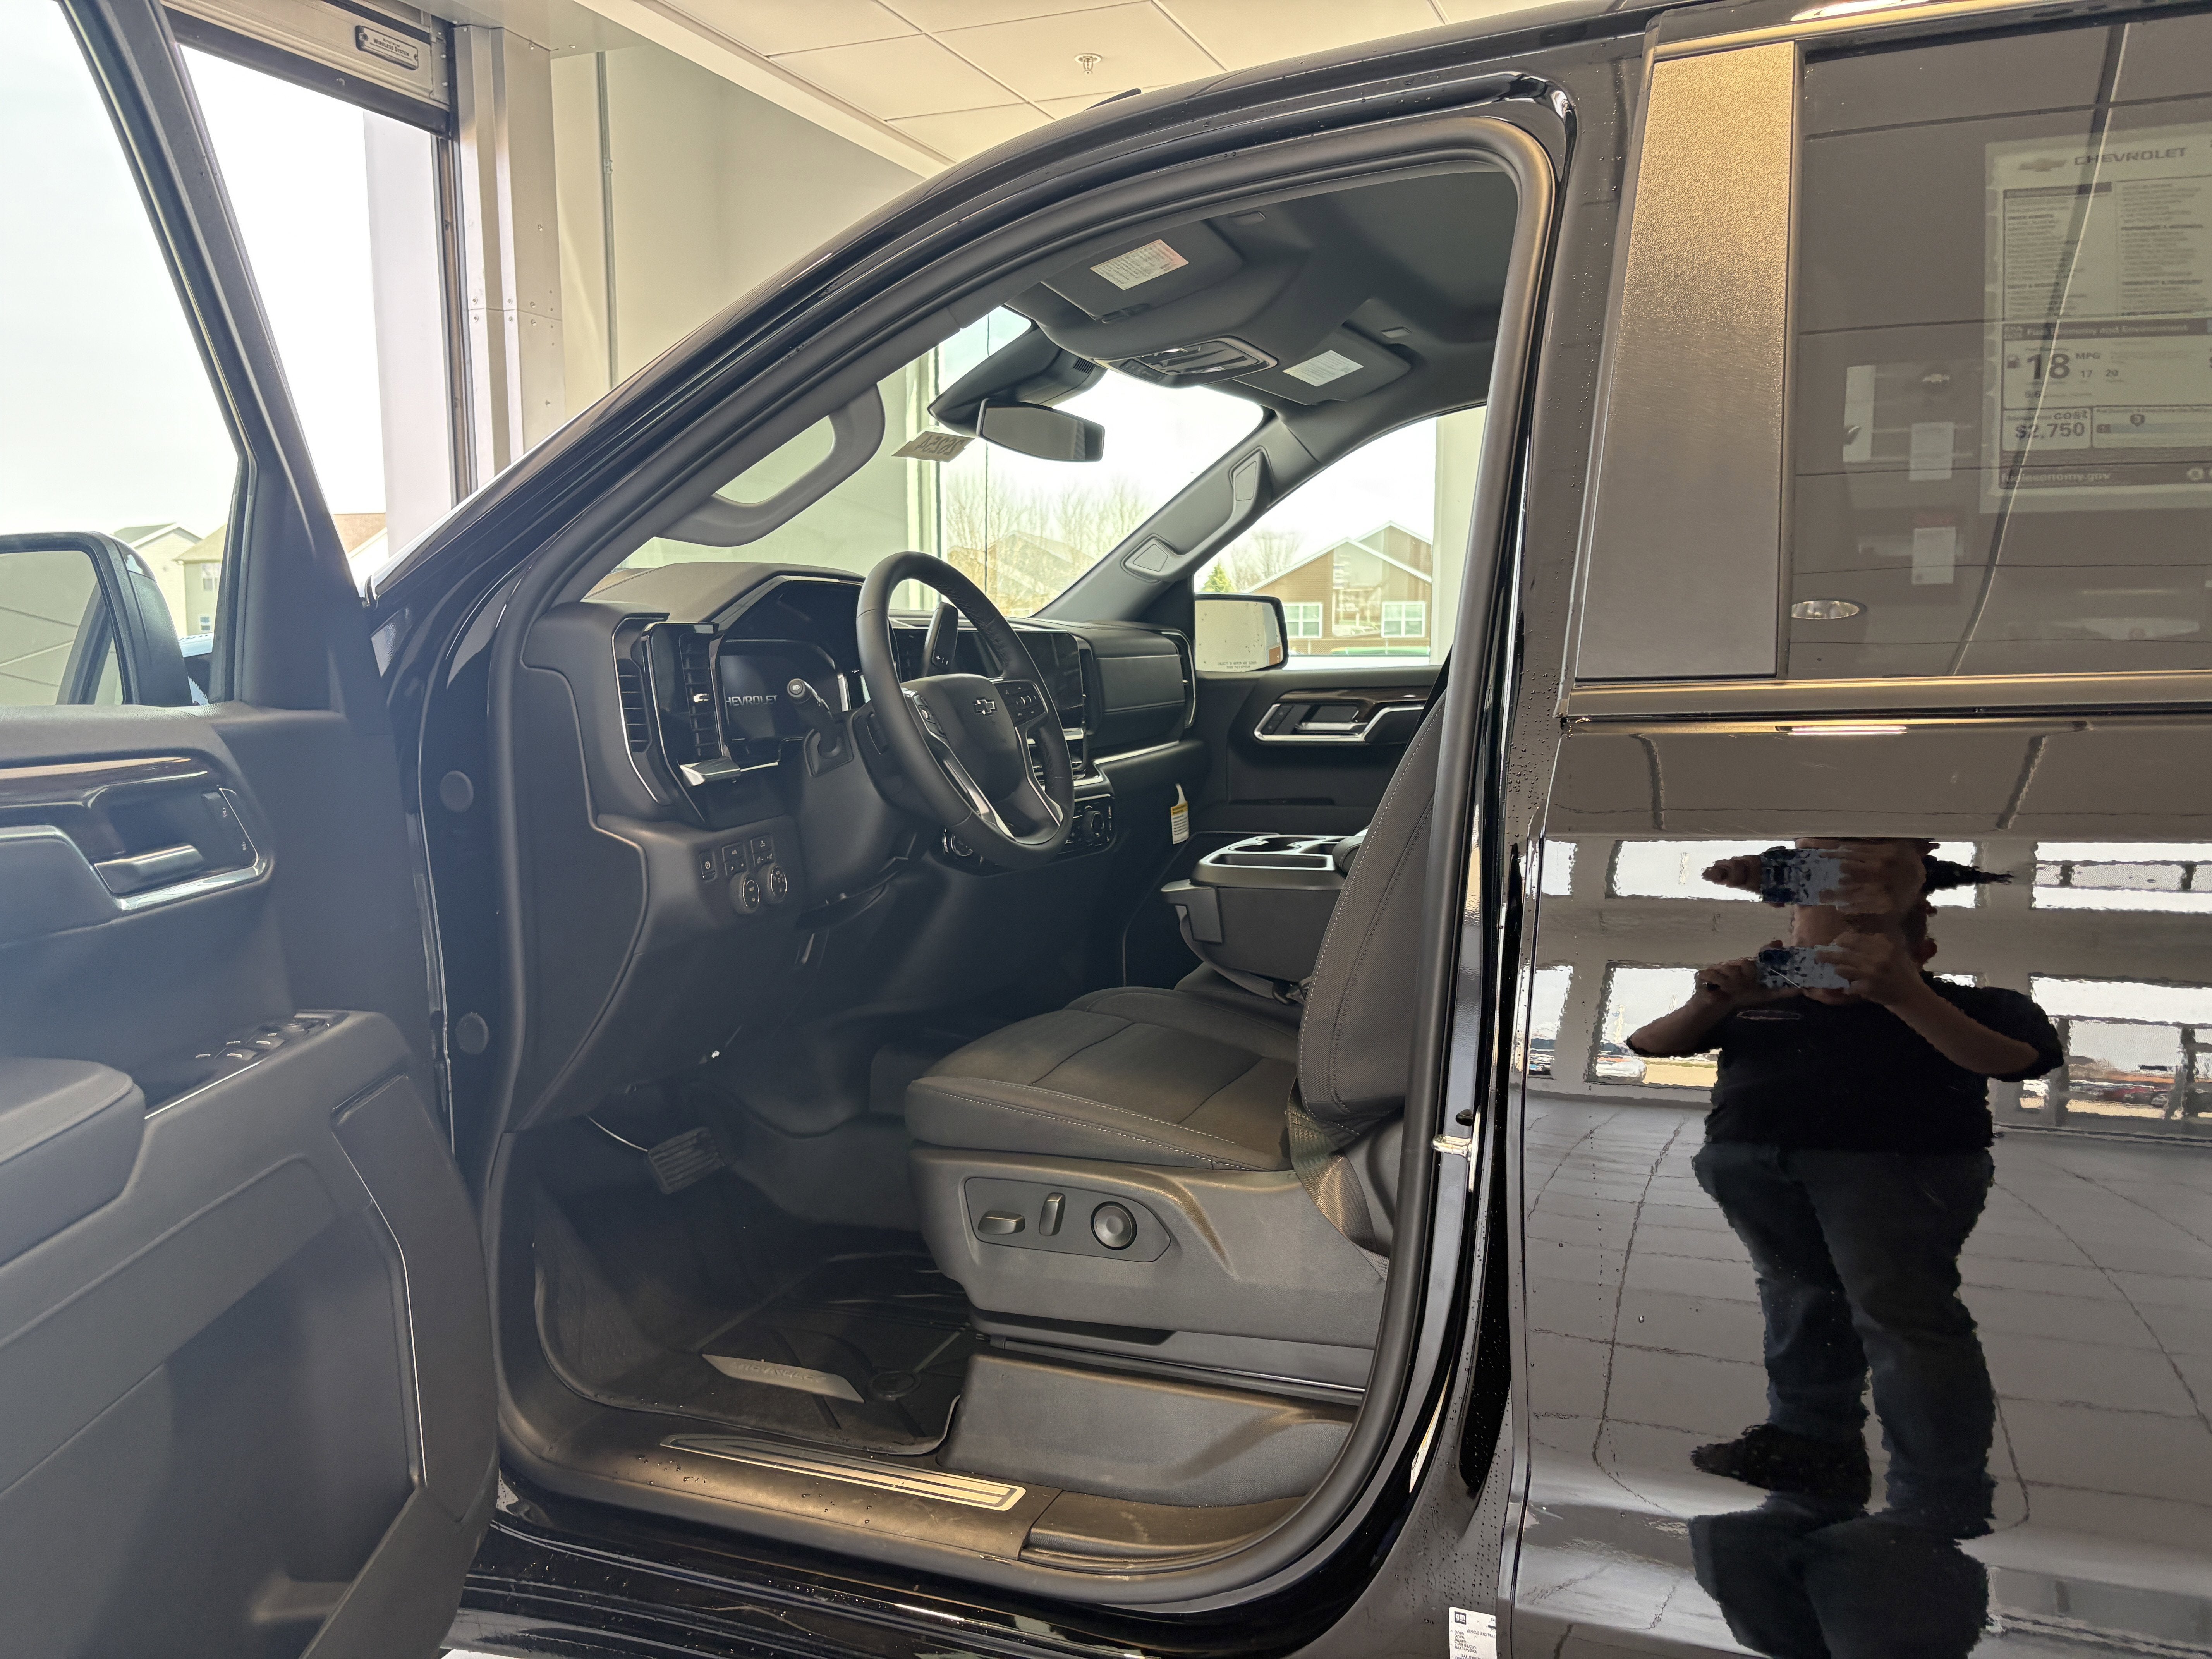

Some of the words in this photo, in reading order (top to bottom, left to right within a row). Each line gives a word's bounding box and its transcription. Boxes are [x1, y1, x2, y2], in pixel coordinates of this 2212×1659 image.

[2074, 147, 2186, 165] CHEVROLET
[2027, 353, 2070, 380] 18
[2081, 370, 2093, 378] 17
[2106, 369, 2119, 377] 20
[2054, 410, 2088, 420] cost
[2015, 422, 2085, 440] $2,750
[725, 695, 778, 706] HEVROLET
[1455, 1613, 1465, 1623] gm
